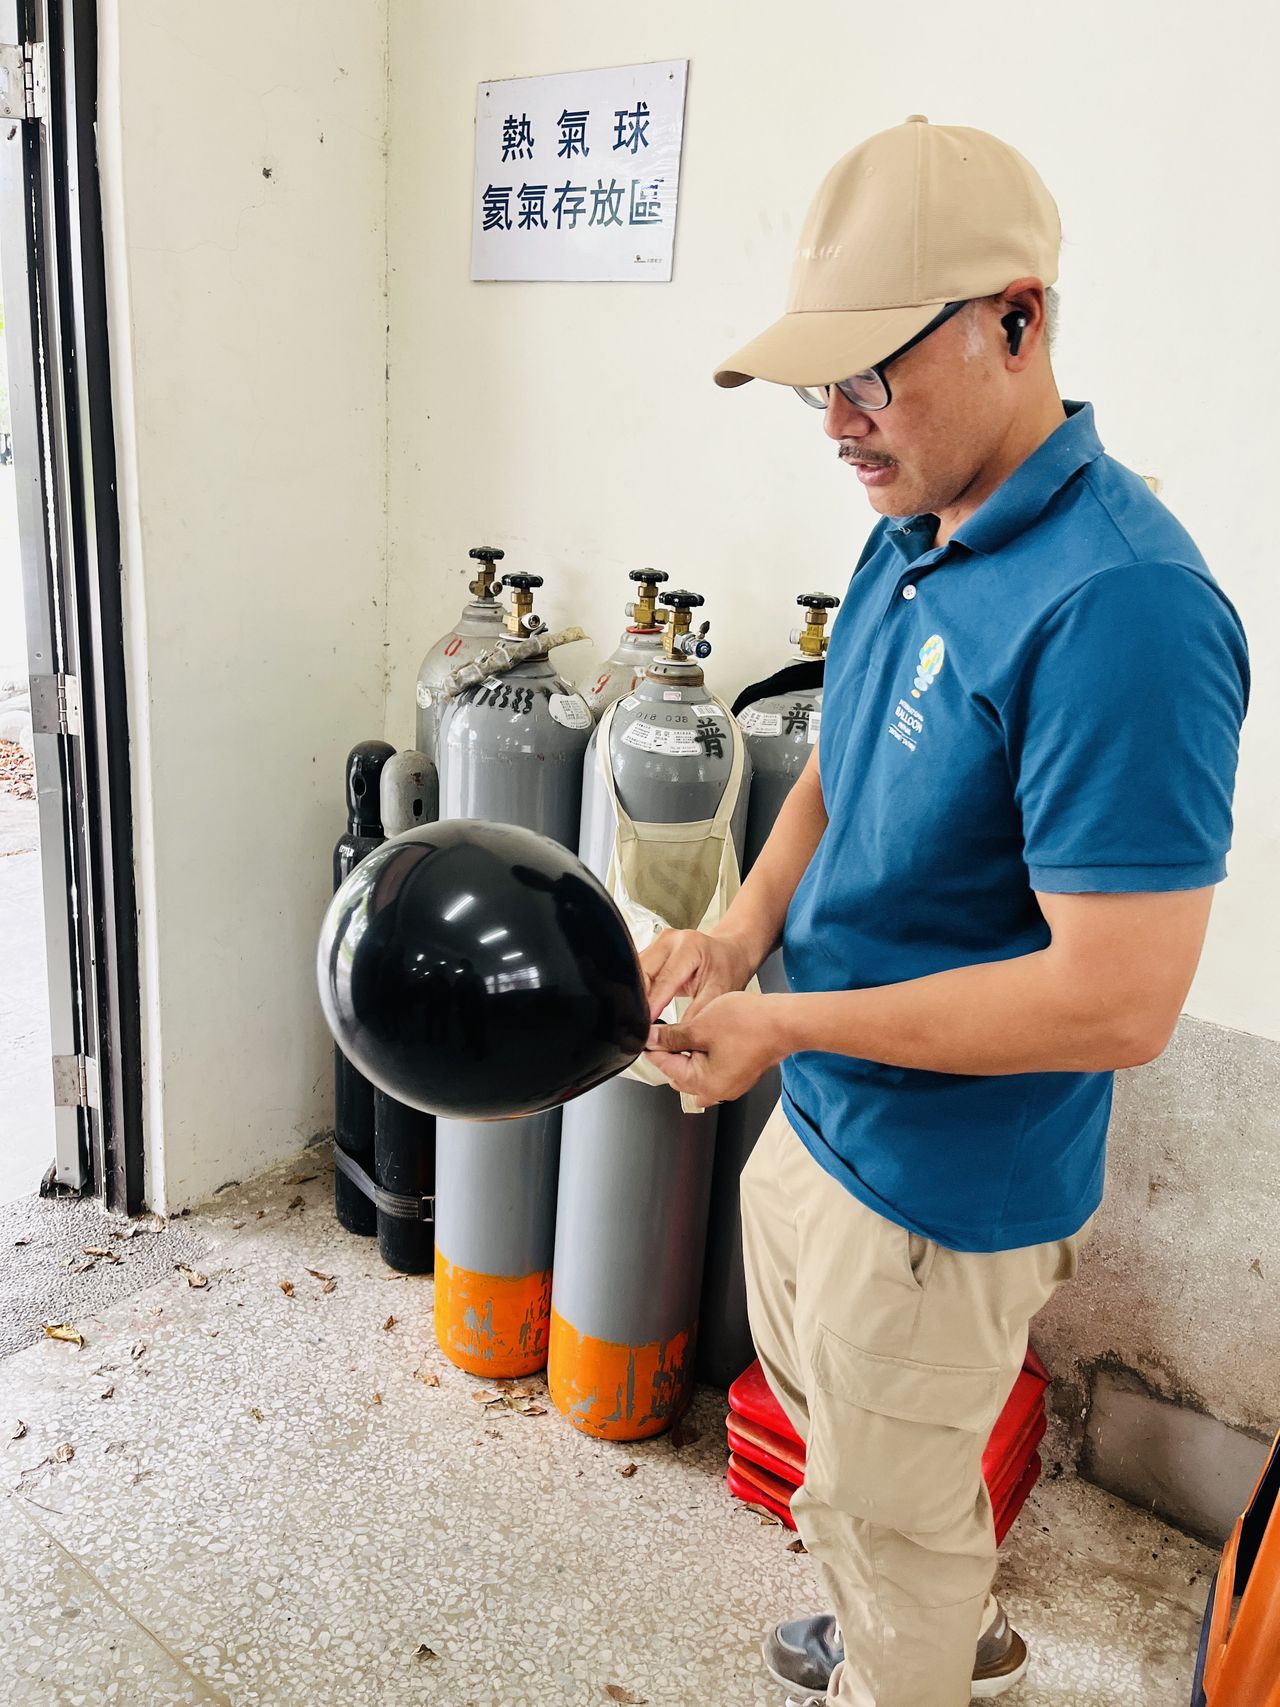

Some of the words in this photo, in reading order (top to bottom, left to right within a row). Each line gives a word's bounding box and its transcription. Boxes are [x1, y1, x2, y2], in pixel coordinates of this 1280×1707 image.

[501, 101, 651, 163] 熱氣球
[482, 177, 665, 232] 氦氣存放區
[695, 717, 727, 759] 普
[895, 705, 923, 734] BALLOON
